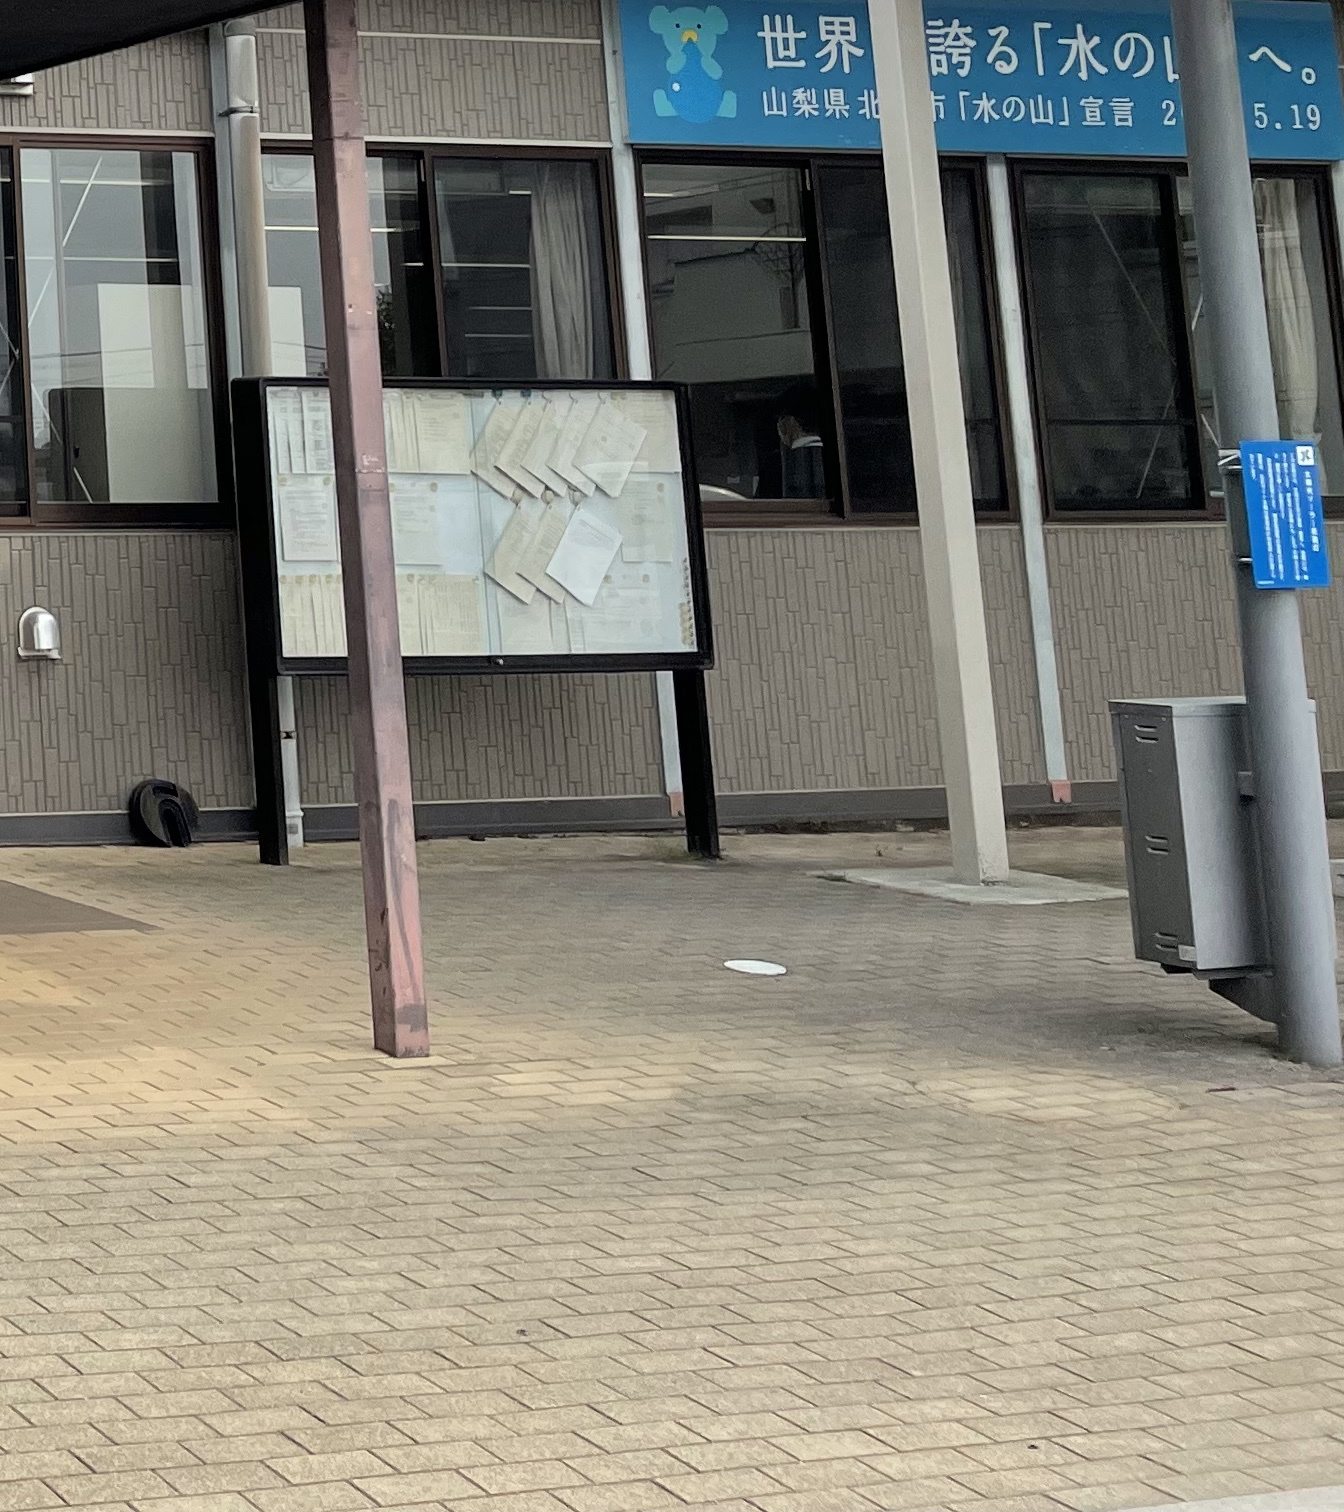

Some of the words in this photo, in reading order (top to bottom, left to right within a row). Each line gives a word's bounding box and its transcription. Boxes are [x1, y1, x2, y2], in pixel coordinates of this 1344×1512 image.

[762, 86, 1134, 126] 山梨県北市「水の山」宣言
